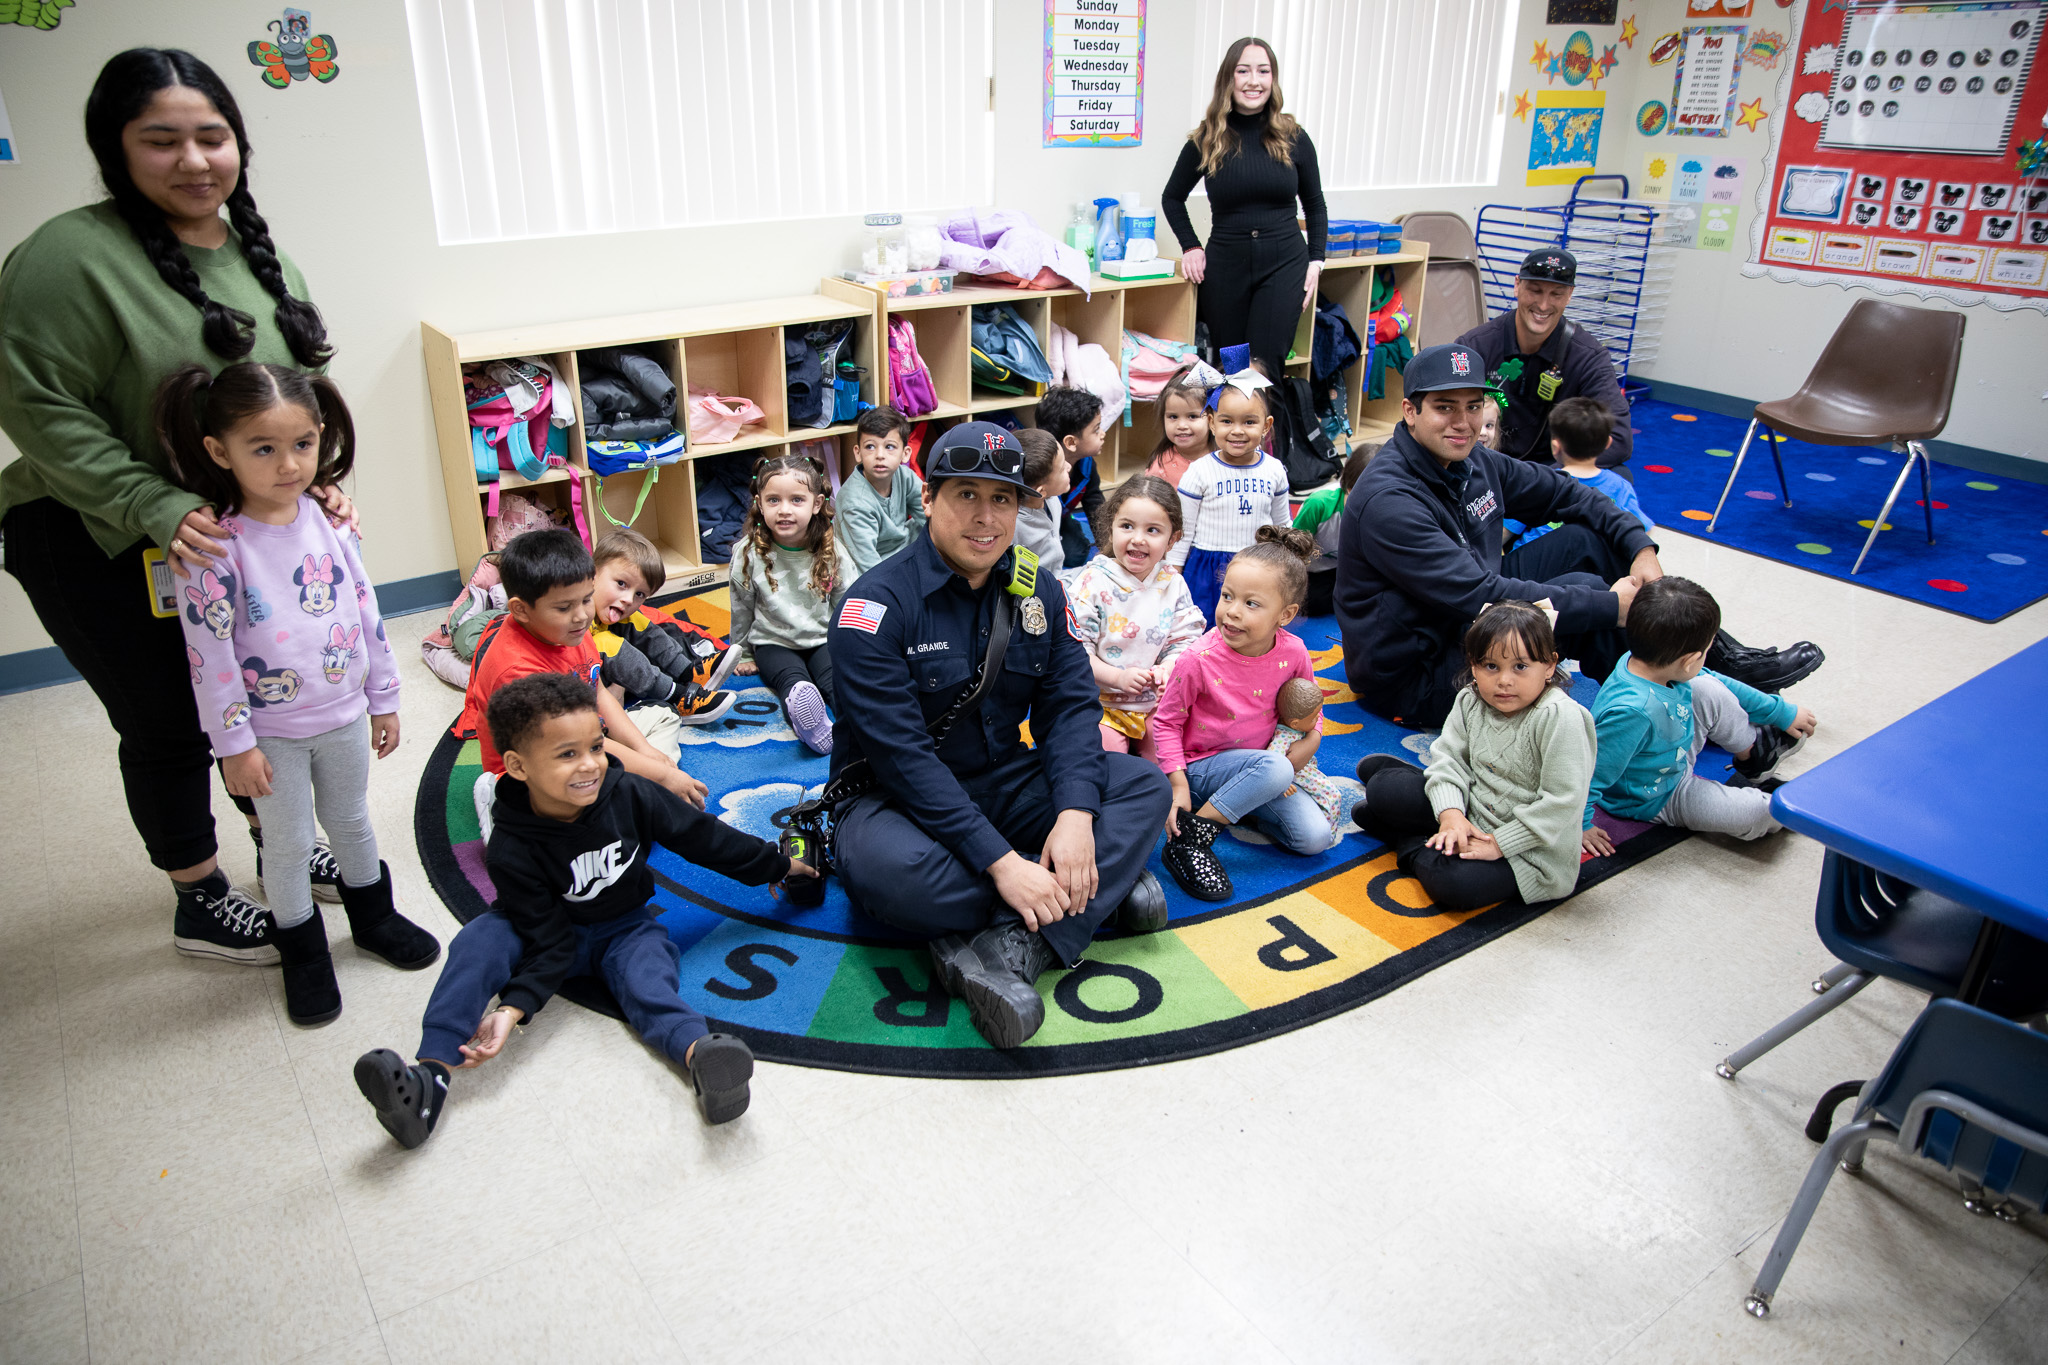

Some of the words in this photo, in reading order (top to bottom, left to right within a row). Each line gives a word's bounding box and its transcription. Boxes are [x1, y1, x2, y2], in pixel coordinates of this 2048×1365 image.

[1076, 0, 1118, 14] Sunday
[1074, 19, 1120, 33] Monday
[1074, 39, 1120, 52] Tuesday
[1064, 60, 1128, 73] Wednesday
[1072, 80, 1120, 93] Thursday
[1078, 100, 1112, 112] Friday
[1070, 120, 1120, 132] Saturday
[1712, 191, 1732, 200] WINDY
[1133, 219, 1154, 228] Fresh
[1774, 248, 1807, 256] yellow
[1825, 252, 1860, 262] orange
[1881, 261, 1910, 270] brown
[1998, 272, 2033, 280] white
[1217, 478, 1271, 496] DODGERS
[1238, 495, 1252, 515] LA
[1477, 498, 1496, 517] FIRE
[918, 642, 949, 652] GRANDE
[570, 840, 622, 895] NIKE
[1258, 914, 1338, 972] P
[704, 942, 799, 1000] S
[873, 967, 950, 1027] R
